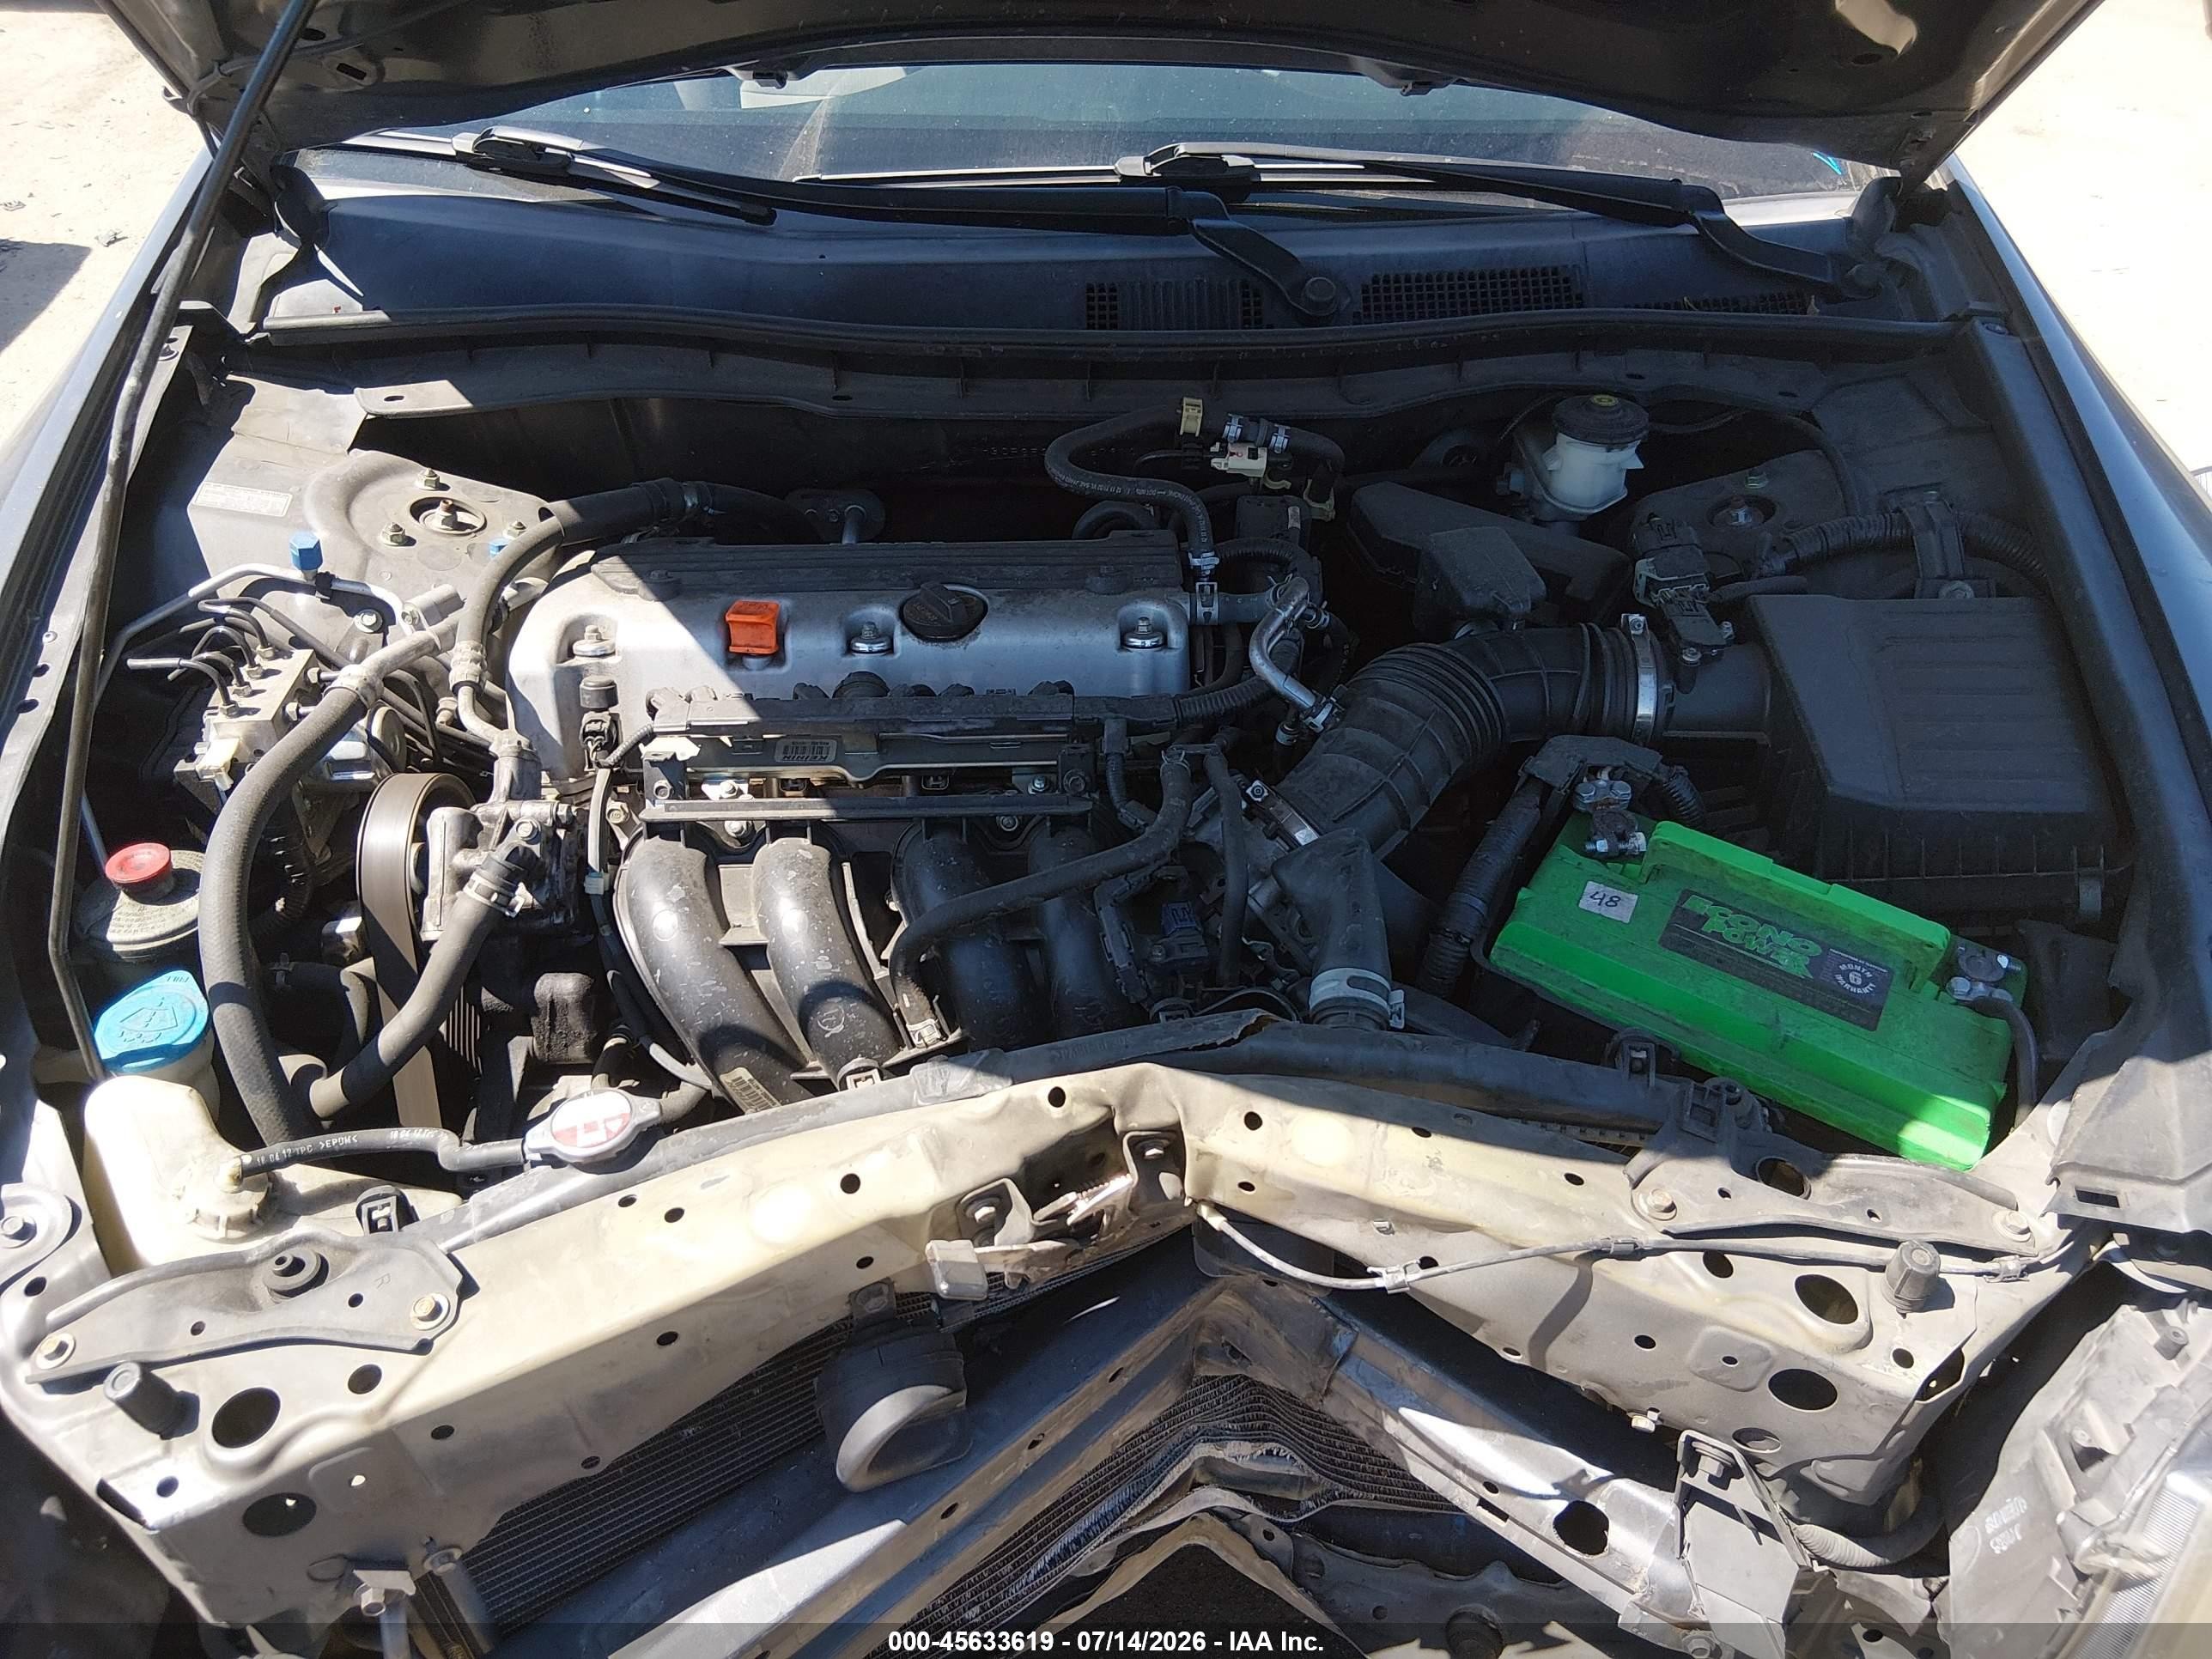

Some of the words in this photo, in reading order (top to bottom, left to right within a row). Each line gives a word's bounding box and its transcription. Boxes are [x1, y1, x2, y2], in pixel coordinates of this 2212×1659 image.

[1589, 891, 1621, 908] 48
[1838, 963, 1873, 978] MONTH
[1849, 971, 1863, 986] 6
[1834, 974, 1876, 994] WARRANTY
